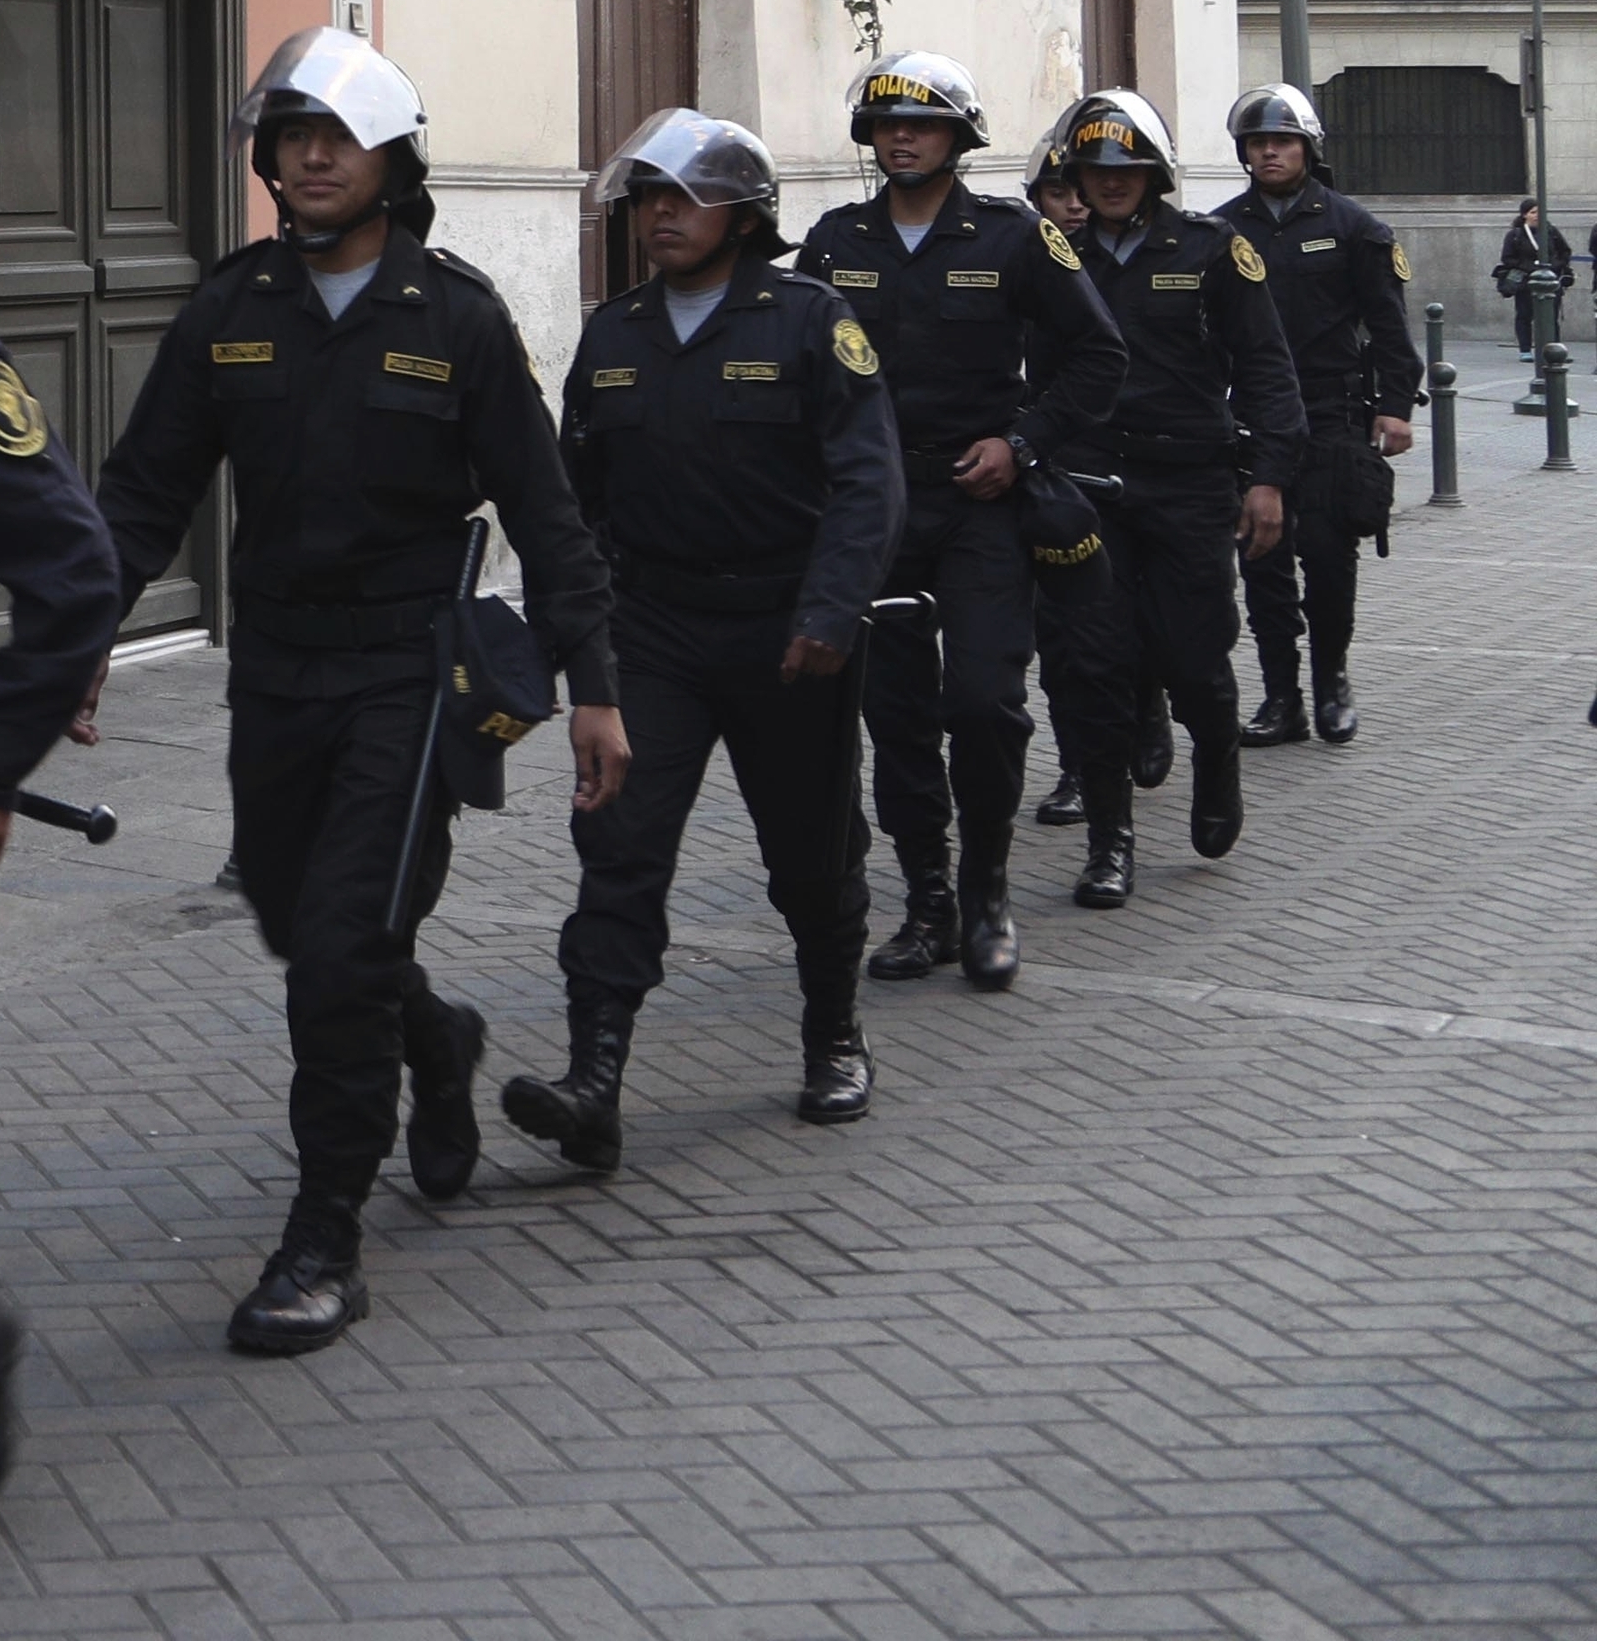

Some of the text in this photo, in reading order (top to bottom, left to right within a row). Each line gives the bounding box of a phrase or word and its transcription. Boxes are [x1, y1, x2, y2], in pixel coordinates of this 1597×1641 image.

[868, 74, 930, 104] POLICIA
[1075, 120, 1134, 151] POLICIA
[1034, 532, 1102, 564] POLICIA
